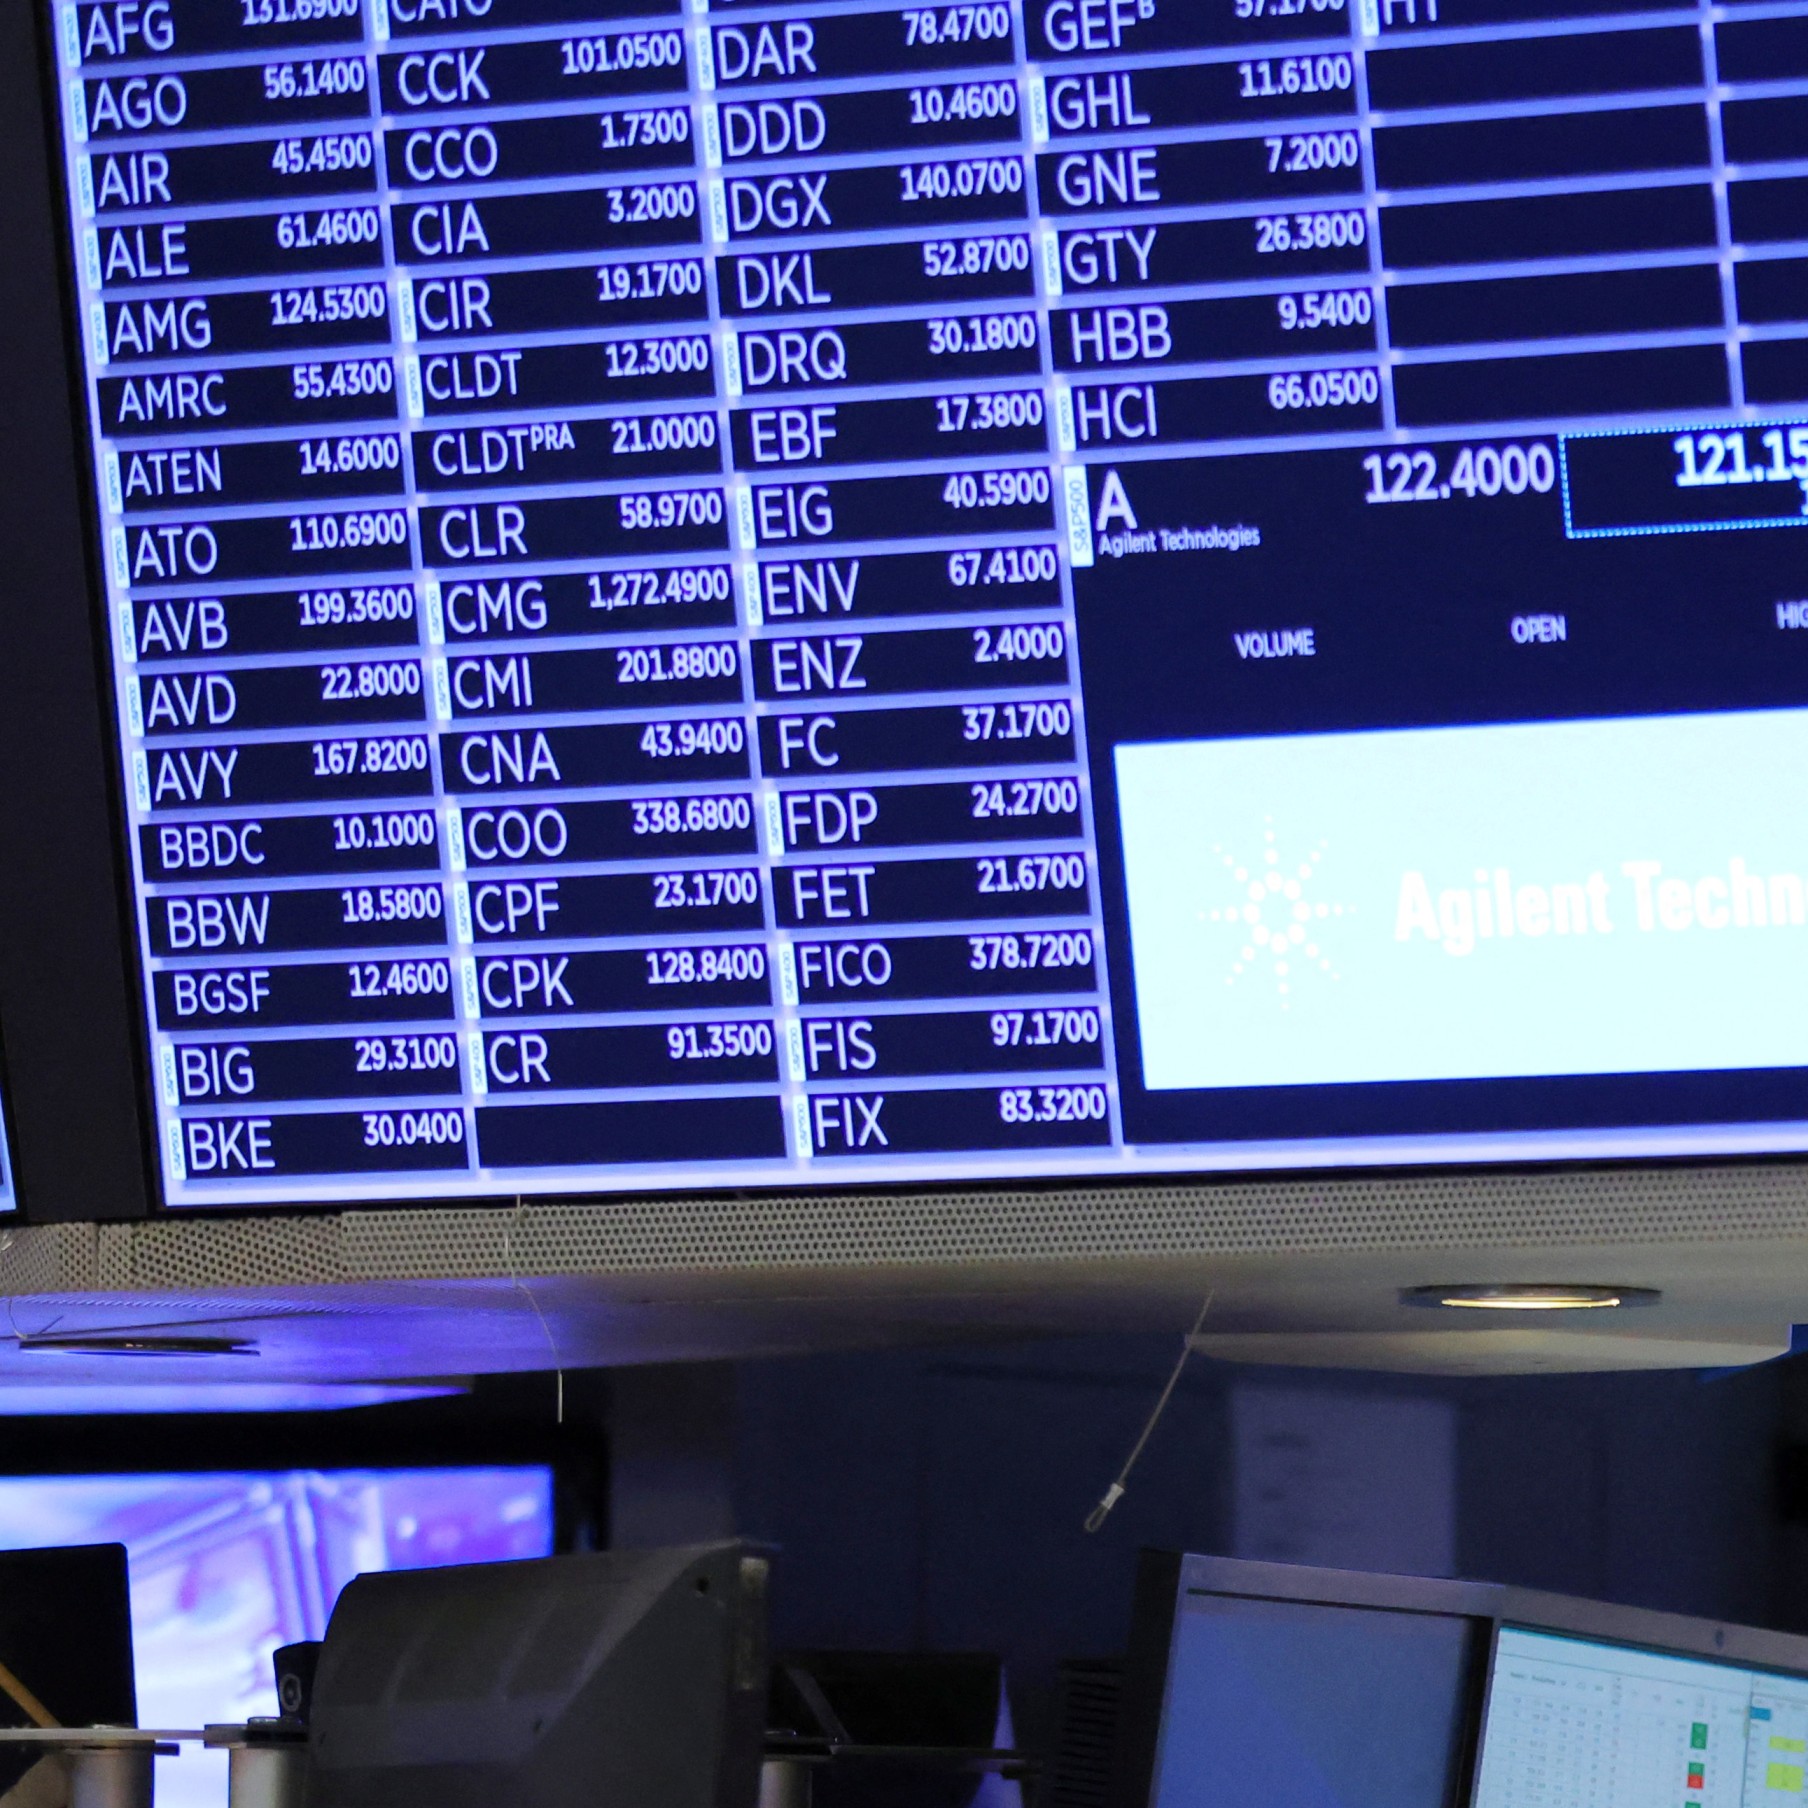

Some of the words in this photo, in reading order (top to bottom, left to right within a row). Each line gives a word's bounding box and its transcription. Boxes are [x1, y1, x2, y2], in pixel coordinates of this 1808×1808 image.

[399, 51, 489, 104] CCK
[563, 34, 681, 73] 101.0500
[718, 24, 815, 79] DAR
[904, 6, 1008, 45] 78.4700
[93, 78, 186, 131] AGO
[266, 61, 364, 98] 56.1400
[1053, 75, 1150, 129] GHL
[1240, 56, 1351, 96] 11.6100
[413, 204, 488, 254] CIA
[608, 186, 694, 222] 3.2000
[732, 176, 830, 231] DGX
[901, 160, 1021, 200] 140.0700
[107, 226, 189, 279] ALE
[278, 210, 378, 247] 61.4600
[1066, 229, 1155, 283] GTY
[1257, 213, 1364, 252] 26.3800
[745, 331, 846, 385] DRQ
[929, 316, 1035, 353] 30.1800
[120, 375, 226, 421] AMRC
[294, 362, 391, 398] 55.4300
[1079, 387, 1156, 440] HCI
[1270, 370, 1377, 409] 66.0500
[612, 416, 714, 453] 21.0000
[759, 487, 832, 538] EIG
[944, 471, 1049, 508] 40.5900
[1097, 472, 1137, 530] A
[1364, 445, 1554, 503] 122.4000
[135, 527, 217, 578] ATO
[291, 513, 405, 550] 110.6900
[1099, 531, 1158, 558] Agilent
[1158, 522, 1262, 551] Technologies
[448, 582, 546, 633] CMG
[589, 569, 728, 610] 1,272.4900
[773, 639, 866, 691] ENZ
[975, 626, 1062, 662] 2.4000
[1236, 630, 1315, 658] VOLUME
[1512, 617, 1565, 643] OPEN
[149, 676, 235, 727] AVD
[322, 664, 419, 699] 22.8000
[462, 733, 560, 784] CNA
[642, 721, 742, 756] 43.9400
[161, 824, 264, 868] BBDC
[334, 814, 434, 849] 10.1000
[787, 793, 877, 844] FDP
[972, 781, 1077, 817] 24.2700
[476, 883, 558, 933] CPF
[654, 872, 757, 907] 23.1700
[1396, 867, 1614, 957] Agilent
[175, 972, 269, 1014] BGSF
[349, 962, 448, 996] 12.4600
[801, 944, 891, 987] FICO
[970, 934, 1091, 969] 378.7200
[188, 1120, 276, 1170] BKE
[363, 1112, 462, 1145] 30.0400
[815, 1097, 888, 1147] FIX
[1001, 1087, 1105, 1122] 83.3200
